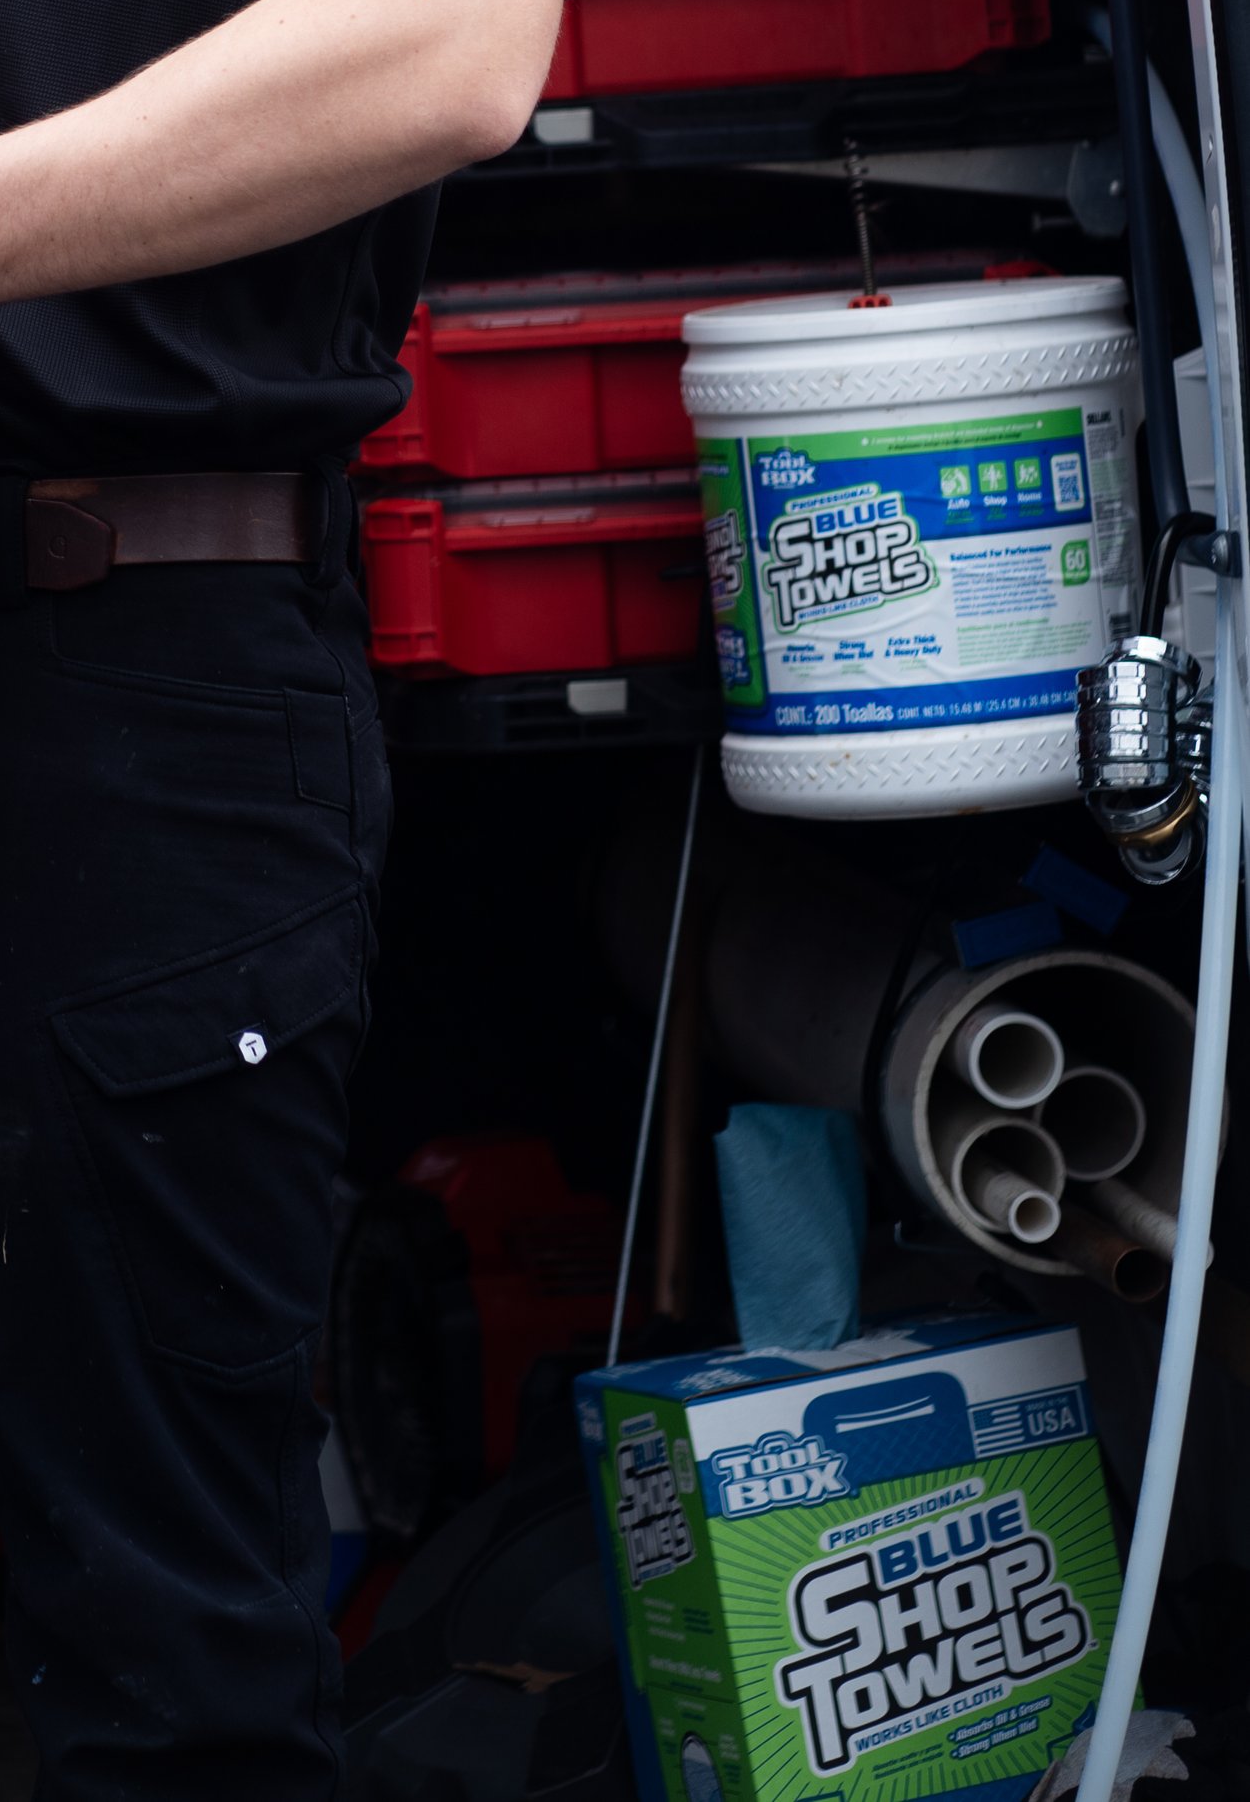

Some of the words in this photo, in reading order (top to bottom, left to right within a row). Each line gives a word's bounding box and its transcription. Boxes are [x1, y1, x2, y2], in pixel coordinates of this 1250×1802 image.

[758, 454, 809, 470] TOOL
[761, 466, 816, 486] BOX
[791, 489, 874, 511] PROFESSIONAL
[816, 497, 899, 534] BLUE
[947, 498, 971, 511] Auto
[982, 495, 1008, 507] Shop
[1017, 491, 1042, 502] Home
[776, 519, 910, 578] SHOP
[1065, 549, 1086, 572] 60
[769, 552, 929, 624] TOWELS
[814, 704, 840, 725] 200
[841, 701, 894, 724] Toallas
[1027, 1405, 1077, 1437] USA
[634, 1437, 666, 1470] BLUE
[718, 1441, 830, 1480] TOOL
[724, 1459, 844, 1513] BOX
[828, 1484, 979, 1550] PROFESSIONAL
[878, 1498, 1024, 1584] BLUE
[801, 1542, 1047, 1673] SHOP
[789, 1594, 1082, 1764] TOWELS
[855, 1720, 913, 1752] WORKS
[915, 1704, 950, 1728] LIKE
[953, 1684, 1004, 1714] CLOTH
[956, 1714, 995, 1741] Absorbs
[995, 1708, 1008, 1726] Oil
[1009, 1706, 1019, 1720] &
[1018, 1696, 1052, 1718] Grease
[958, 1734, 992, 1758] Strong
[991, 1723, 1019, 1746] When
[1018, 1717, 1038, 1737] Wet
